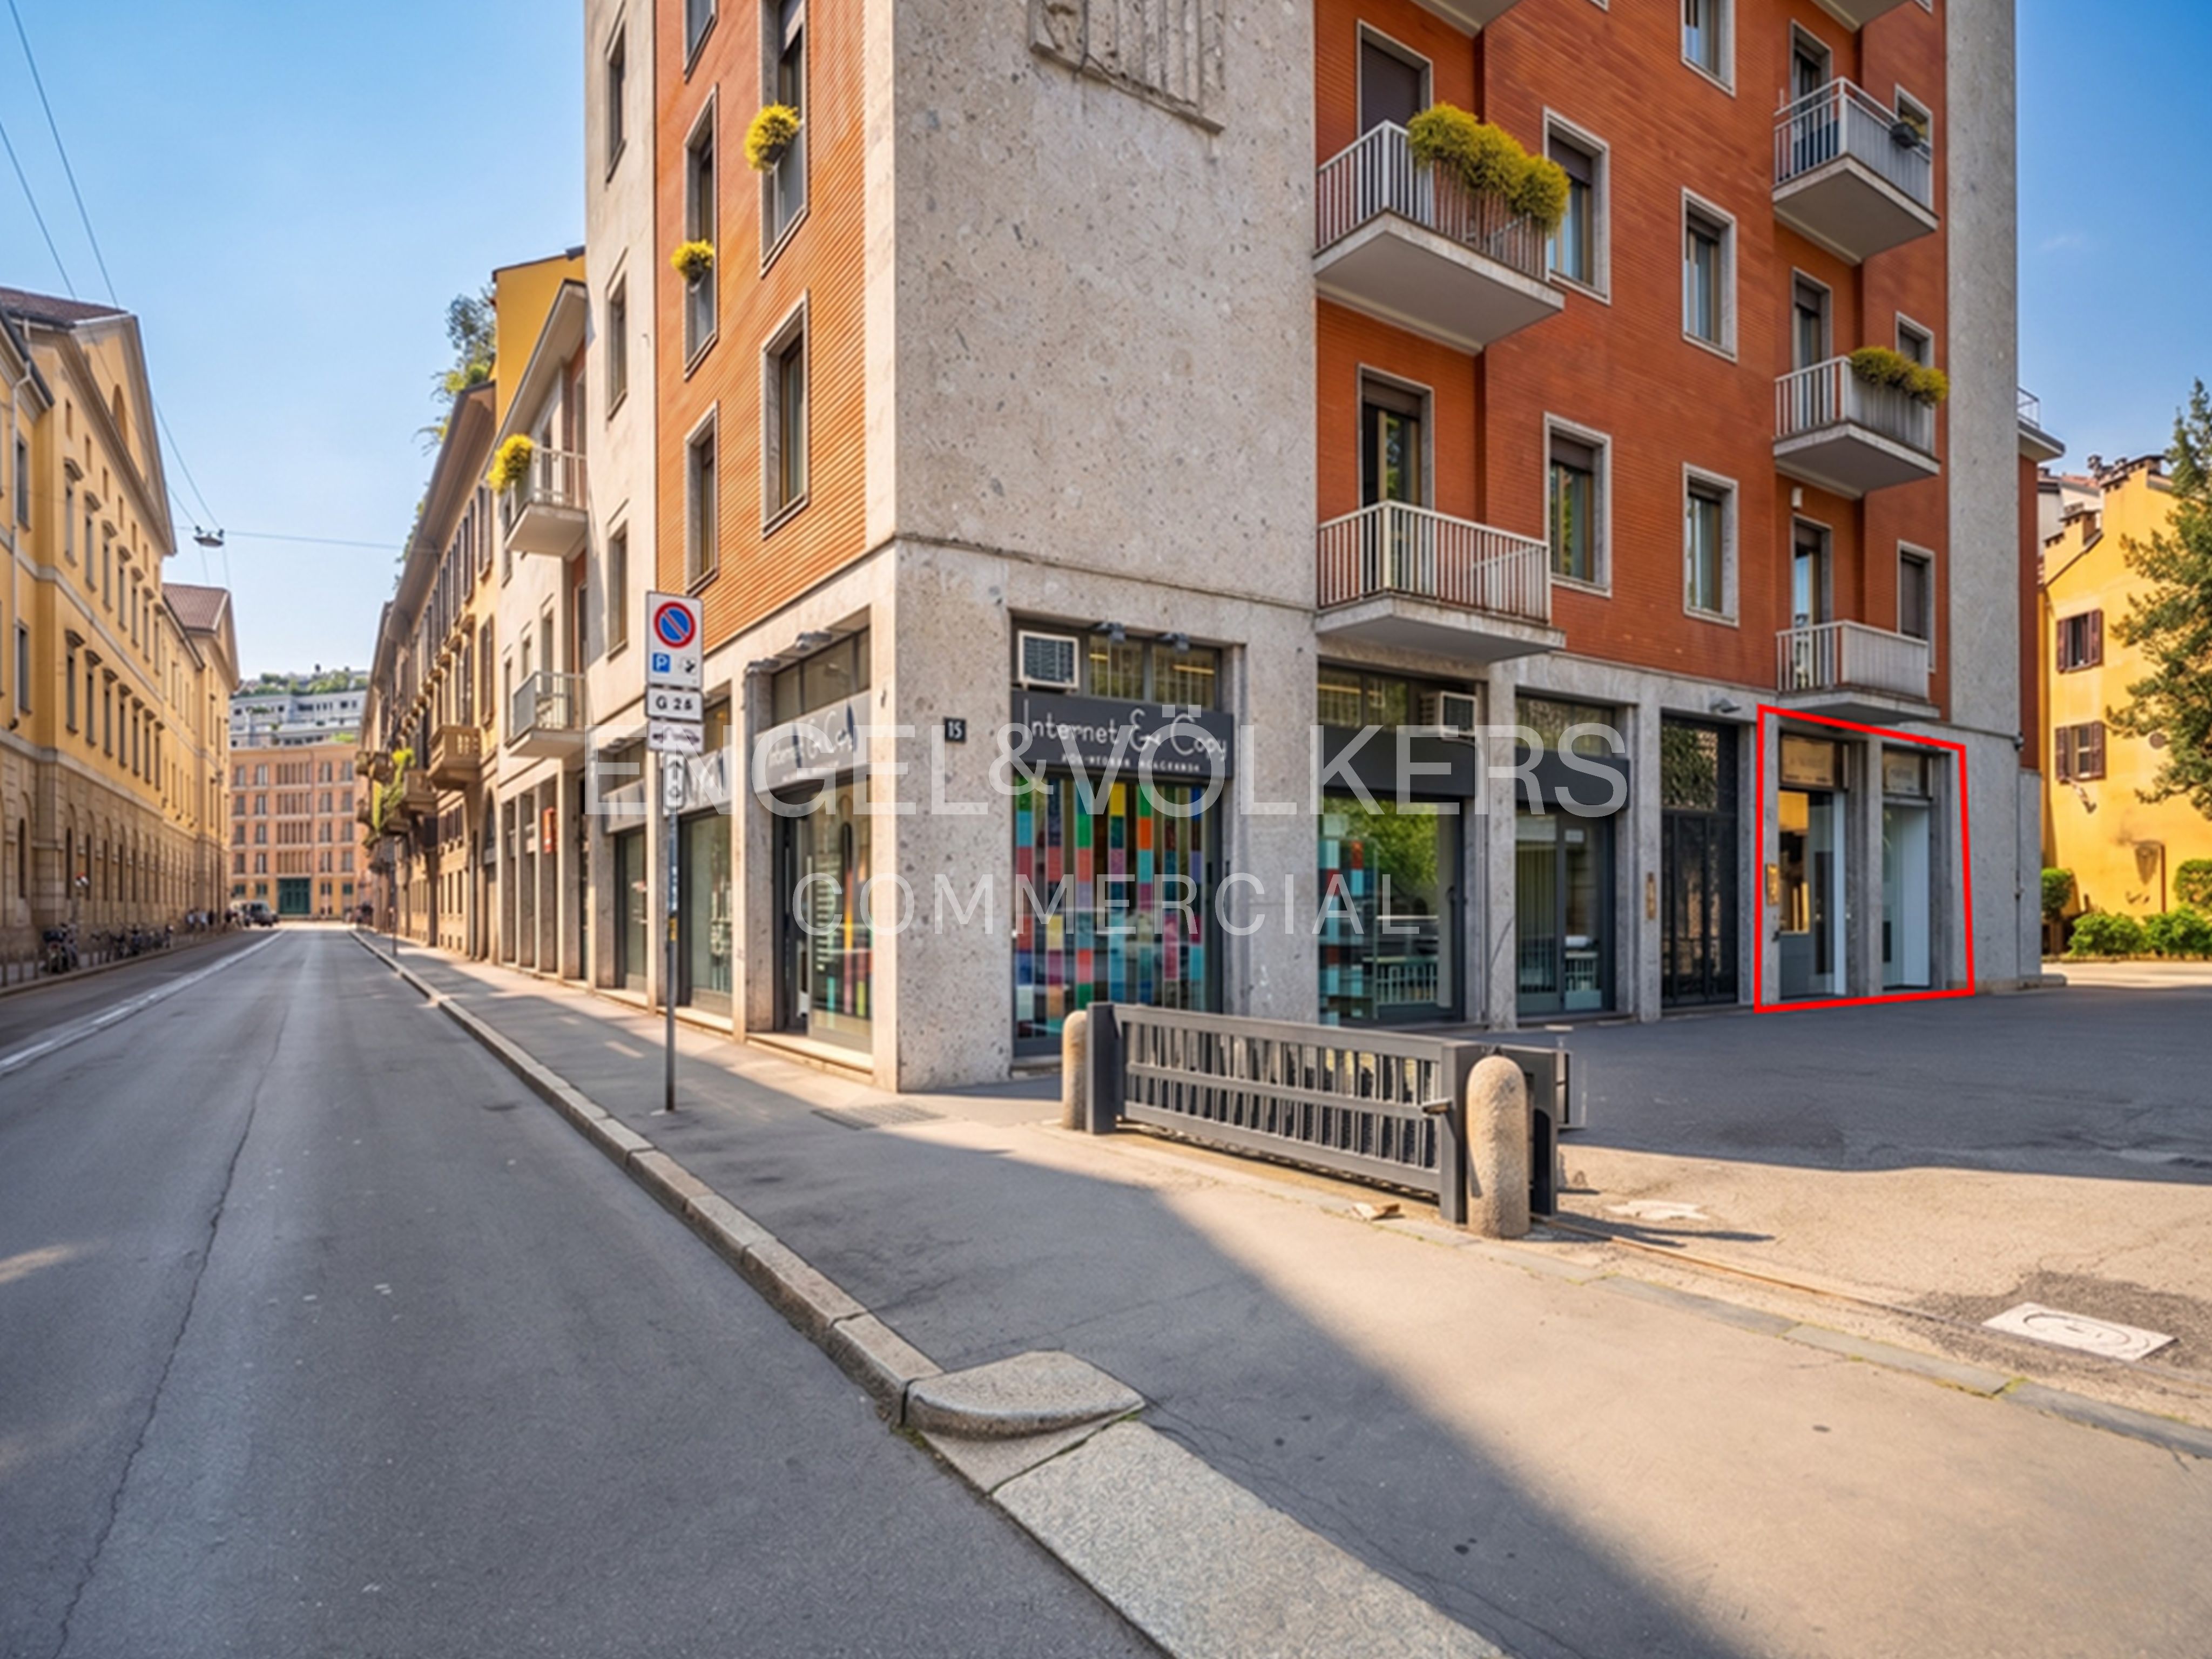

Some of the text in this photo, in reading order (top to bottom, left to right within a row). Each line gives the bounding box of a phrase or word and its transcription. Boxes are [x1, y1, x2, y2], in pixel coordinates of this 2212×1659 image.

[948, 721, 962, 739] 15
[1024, 699, 1120, 745] Internet
[1170, 713, 1227, 761] Copy
